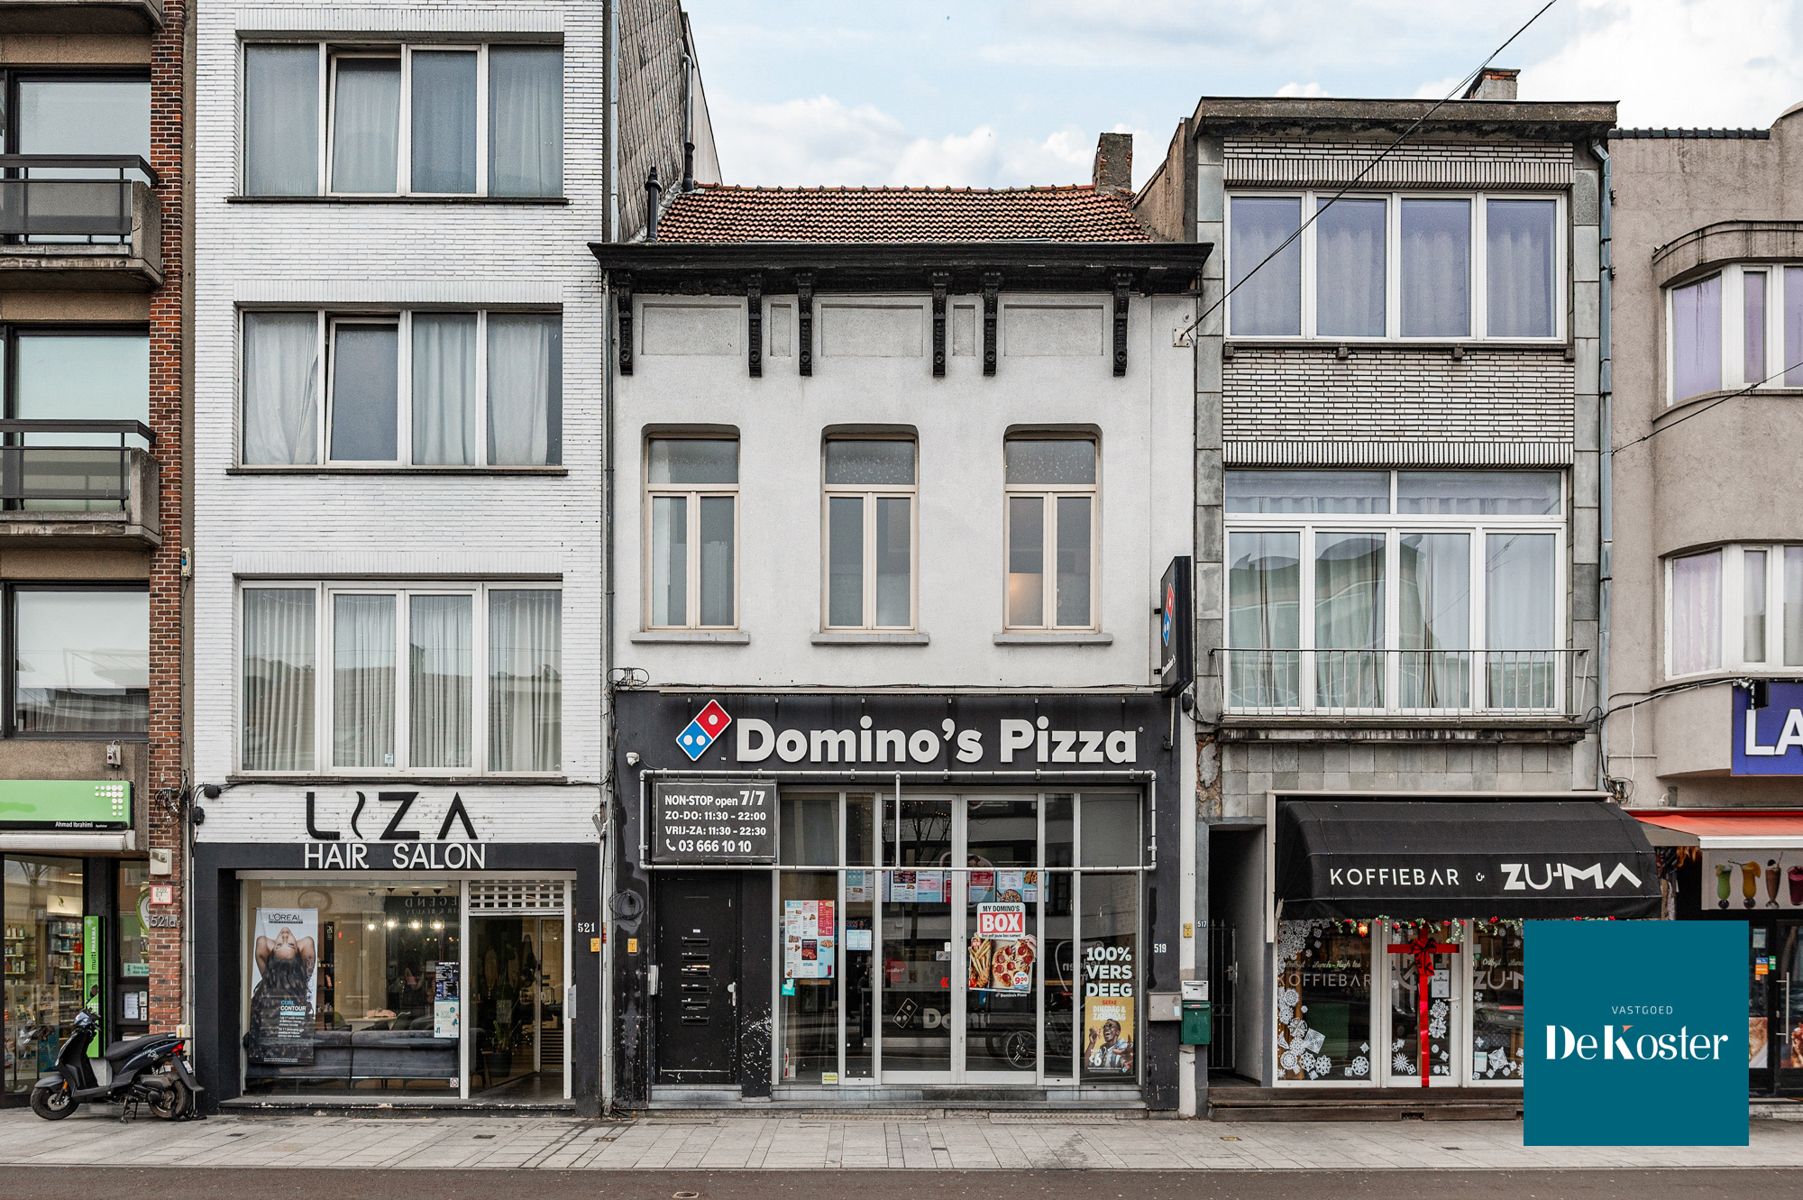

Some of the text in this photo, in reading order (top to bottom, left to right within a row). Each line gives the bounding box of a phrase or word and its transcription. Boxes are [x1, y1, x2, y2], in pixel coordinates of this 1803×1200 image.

[736, 715, 1137, 764] Domino's Pizza
[1745, 708, 1803, 756] LA
[664, 790, 766, 808] NON-STOP open 7/7
[306, 791, 479, 841] LIZA
[665, 811, 702, 820] ZO-DO:
[704, 811, 729, 820] 11:30
[738, 812, 766, 821] 22:00
[665, 825, 706, 835] VRIJ-ZA:
[708, 826, 731, 835] 11:30
[739, 827, 767, 836] 22:30
[678, 839, 752, 852] 03 666 10 10
[304, 843, 486, 869] HAIR SALON
[1329, 862, 1643, 890] KOFFIEBAR ZUMA
[150, 915, 177, 928] 521a
[577, 922, 595, 933] 521
[982, 913, 1021, 932] BOX
[1086, 946, 1132, 961] 100%
[1153, 943, 1167, 953] 519
[1086, 964, 1133, 980] VERS
[1086, 982, 1133, 997] DEEG
